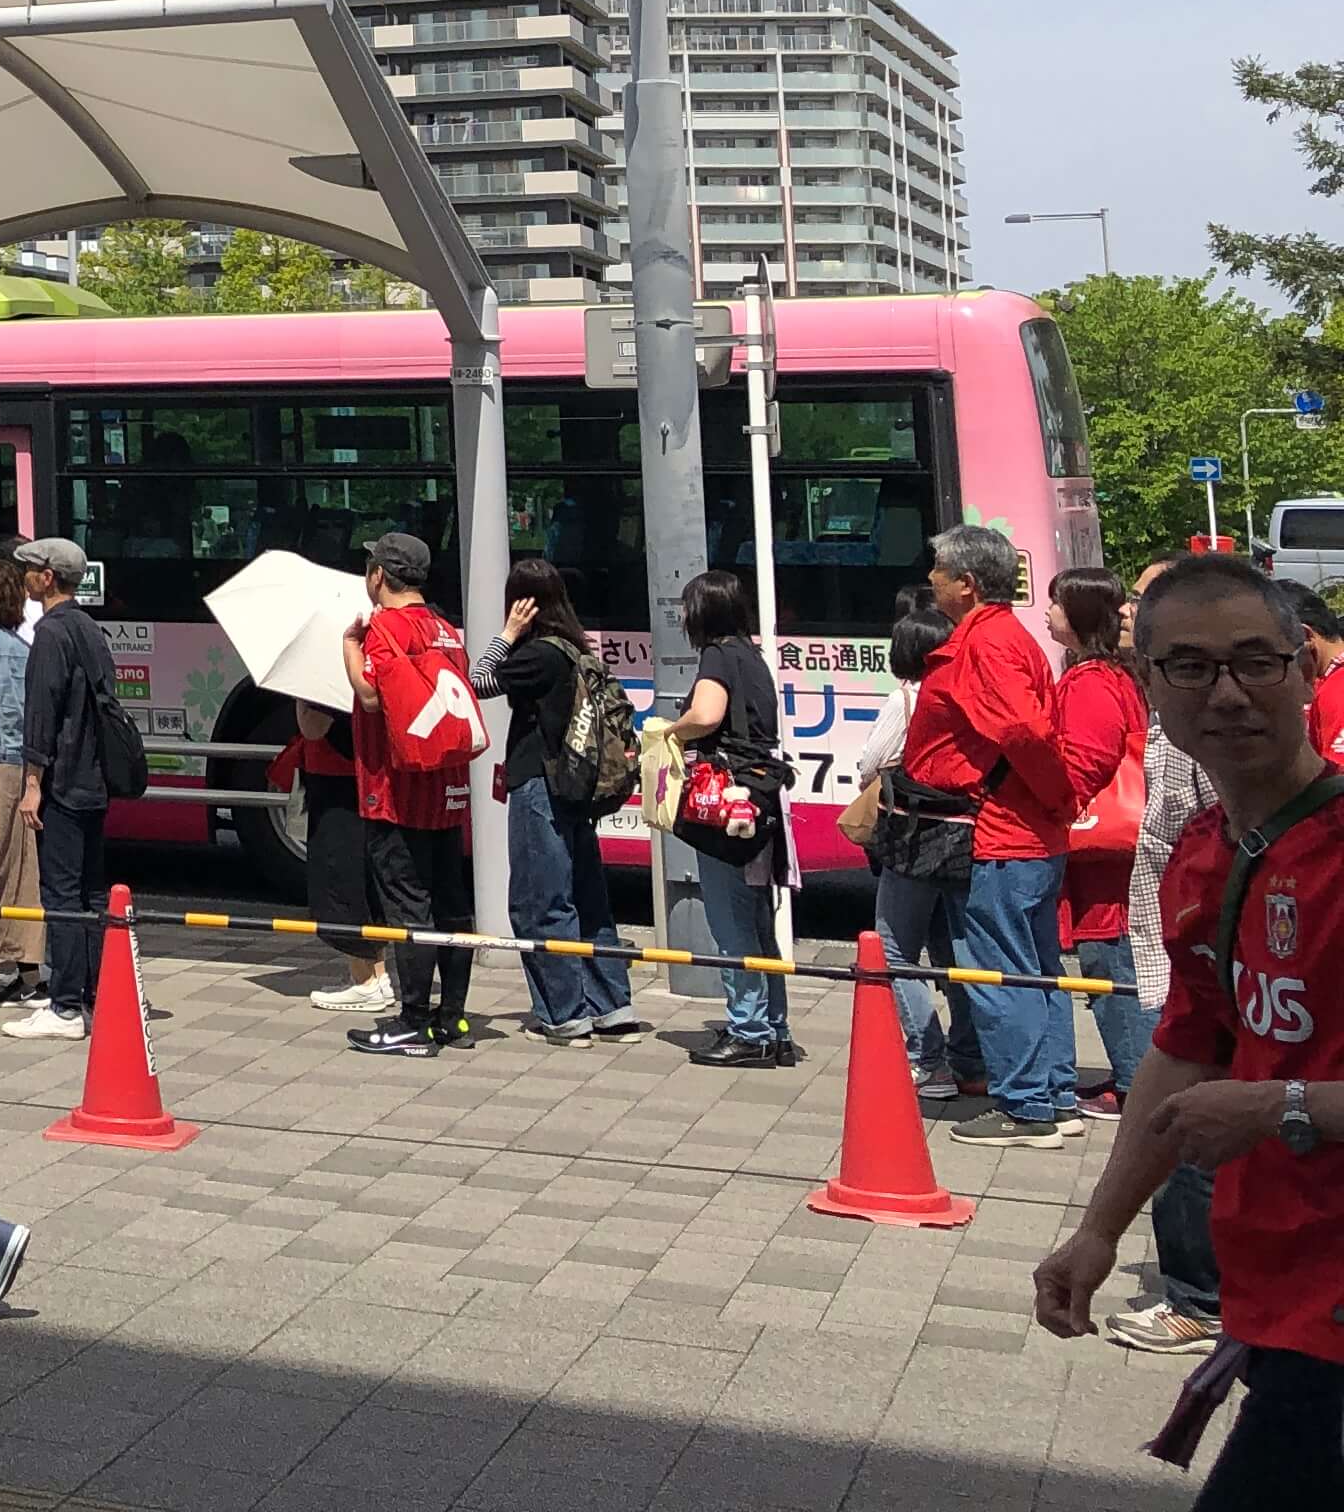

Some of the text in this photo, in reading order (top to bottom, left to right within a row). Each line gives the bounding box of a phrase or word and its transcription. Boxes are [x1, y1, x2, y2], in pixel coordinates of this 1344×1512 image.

[116, 625, 148, 639] 入口
[112, 643, 152, 653] ENTRANCE
[777, 642, 887, 673] 食品通販
[115, 668, 145, 680] smo
[783, 683, 880, 738] リー
